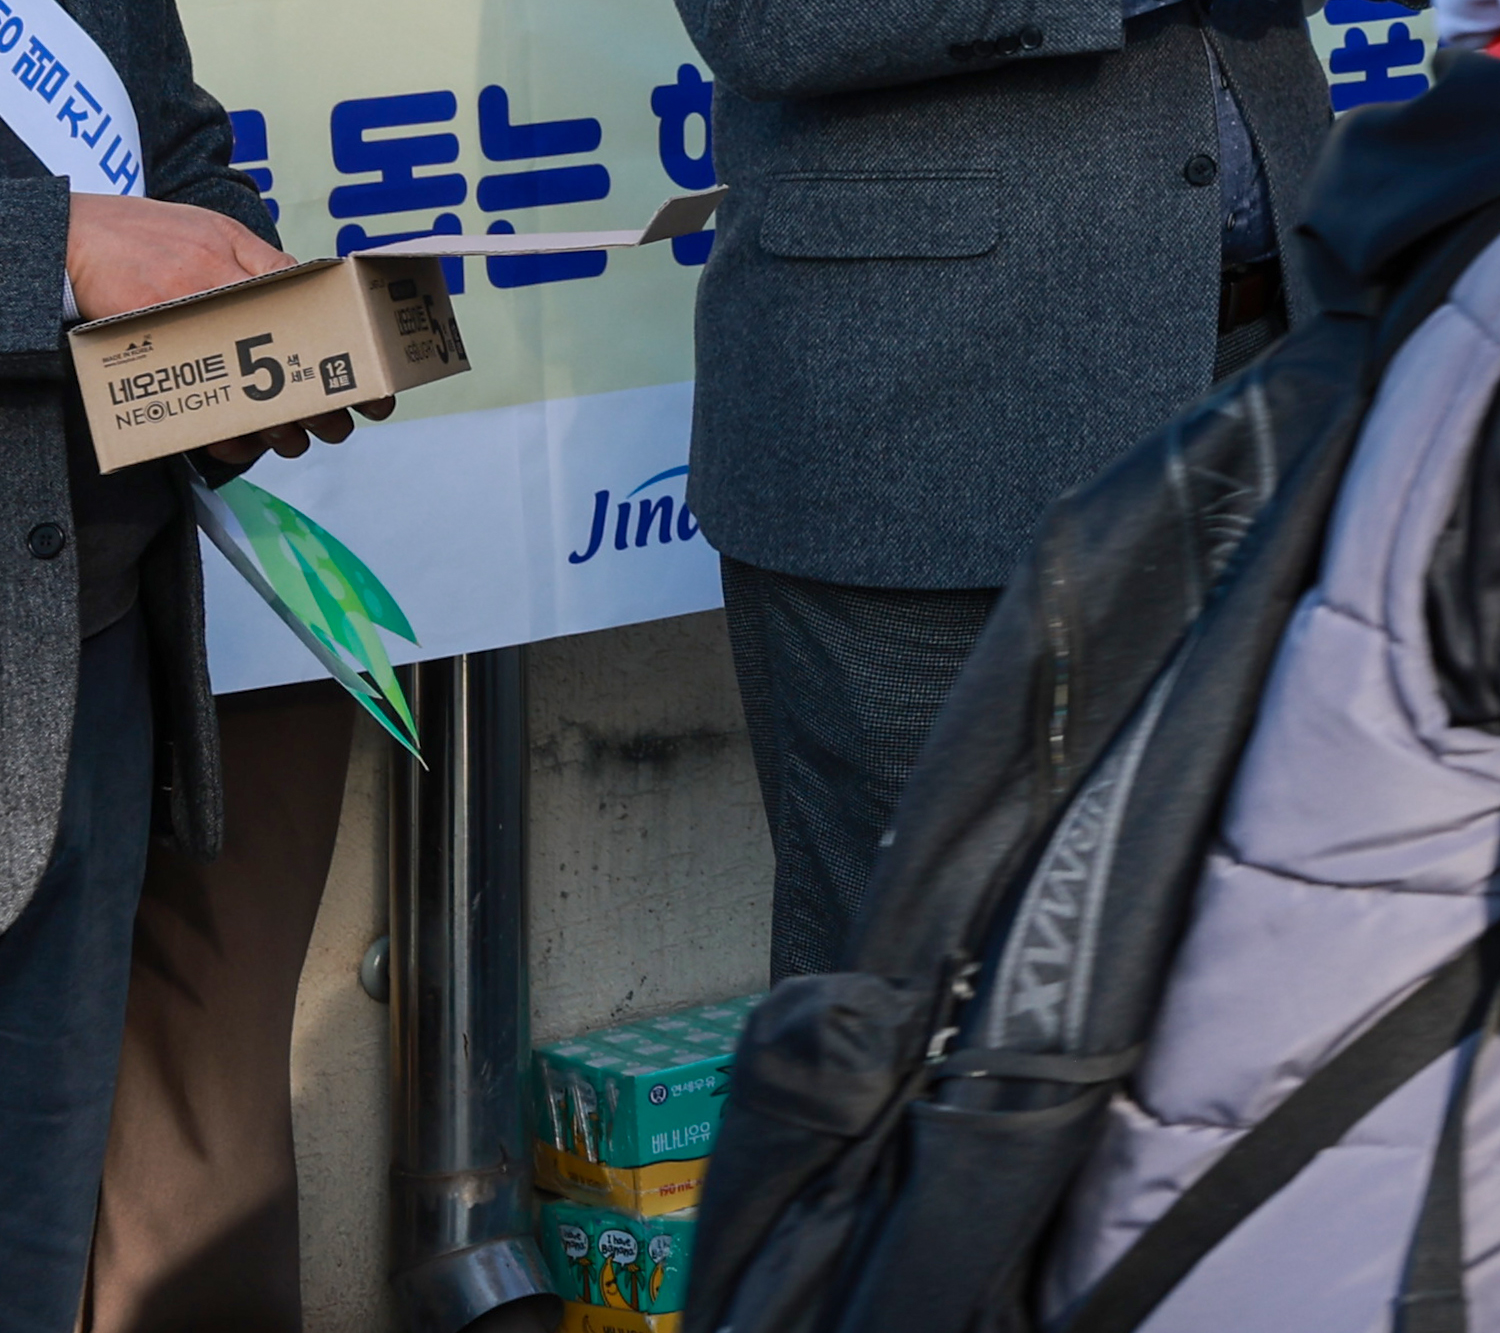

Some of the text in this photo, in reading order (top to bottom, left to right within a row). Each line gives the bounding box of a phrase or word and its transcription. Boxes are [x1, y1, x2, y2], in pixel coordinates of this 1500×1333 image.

[235, 332, 285, 401] 5
[286, 353, 301, 367] 색
[325, 360, 347, 377] 12
[108, 353, 229, 405] 네오라이트
[291, 366, 316, 383] 세트
[328, 375, 350, 389] 세트
[115, 385, 231, 430] NEOLIGHT
[670, 1075, 716, 1097] 연세우유
[651, 1121, 711, 1155] 바나나우유
